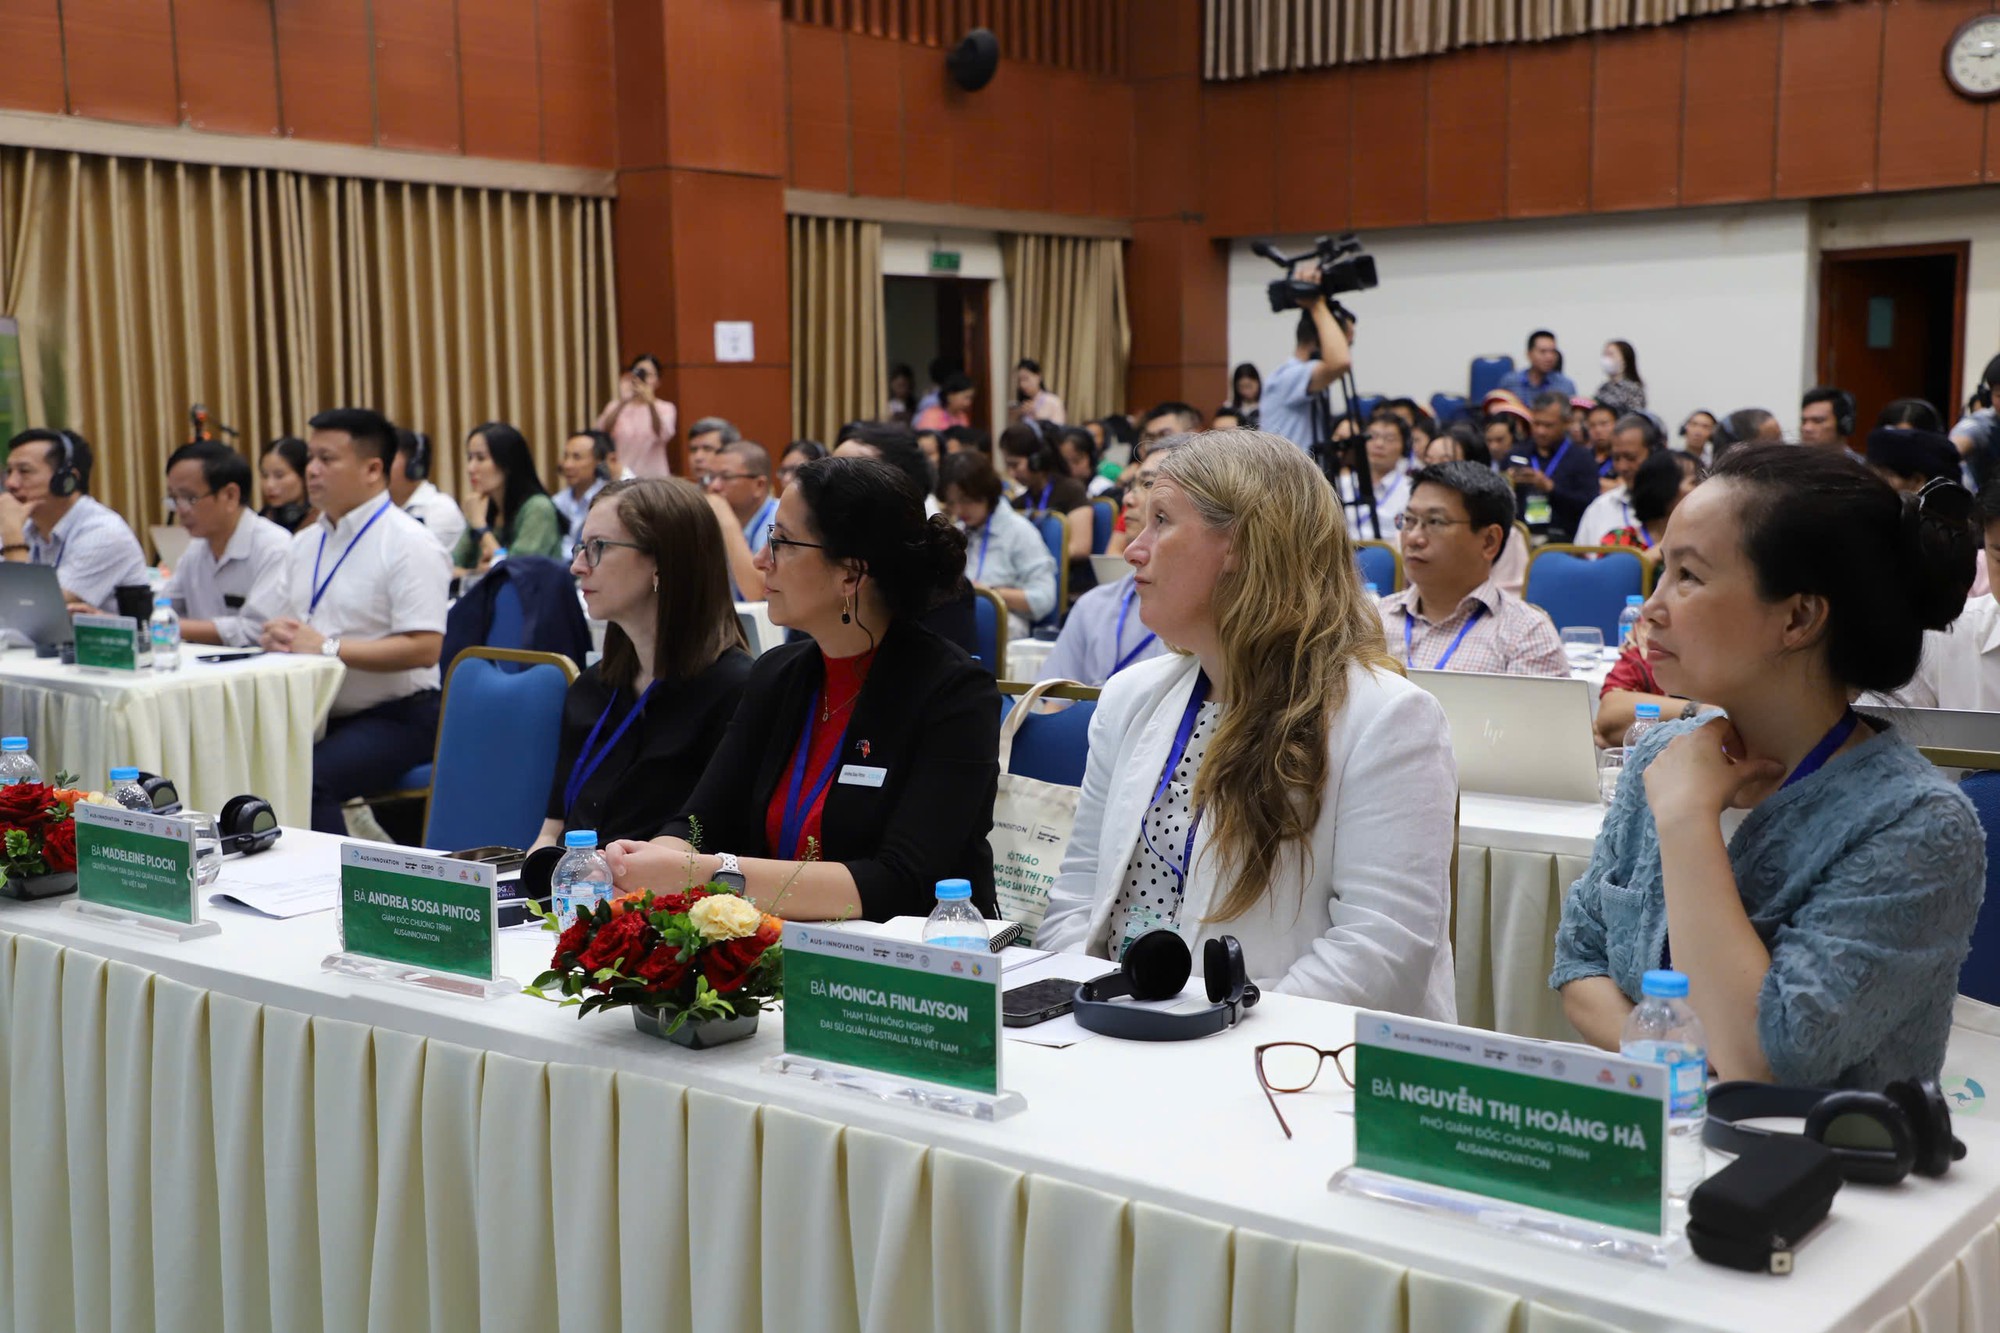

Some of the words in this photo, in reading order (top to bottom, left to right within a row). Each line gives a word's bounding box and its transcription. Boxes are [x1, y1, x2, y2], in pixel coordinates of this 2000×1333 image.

[102, 846, 146, 866] MADELEINE
[147, 855, 176, 872] PLOCKI
[1025, 870, 1041, 883] THỊ
[1023, 884, 1042, 896] VIỆT
[354, 888, 366, 903] BÀ
[368, 891, 409, 910] ANDREA
[411, 899, 440, 915] SOSA
[442, 904, 480, 922] PINTOS
[896, 951, 914, 960] CSIRO
[811, 979, 827, 997] BÀ
[829, 982, 887, 1008] MONICA
[890, 993, 968, 1023] FINLAYSON
[842, 1009, 863, 1020] THAM
[865, 1012, 879, 1024] TÁN
[880, 1015, 904, 1028] NÔNG
[906, 1021, 934, 1035] NGHIỆP
[820, 1019, 832, 1031] ĐẠI
[845, 1024, 867, 1036] QUÁN
[869, 1029, 908, 1044] AUSTRALIA
[910, 1036, 922, 1048] TẠI
[923, 1039, 939, 1051] VIỆT
[941, 1043, 959, 1054] NAM
[1372, 1077, 1395, 1099] BÀ
[1400, 1082, 1483, 1117] NGUYỄN
[1487, 1100, 1520, 1130] THỊ
[1525, 1107, 1609, 1142] HOÀNG
[1613, 1123, 1647, 1151] HÀ
